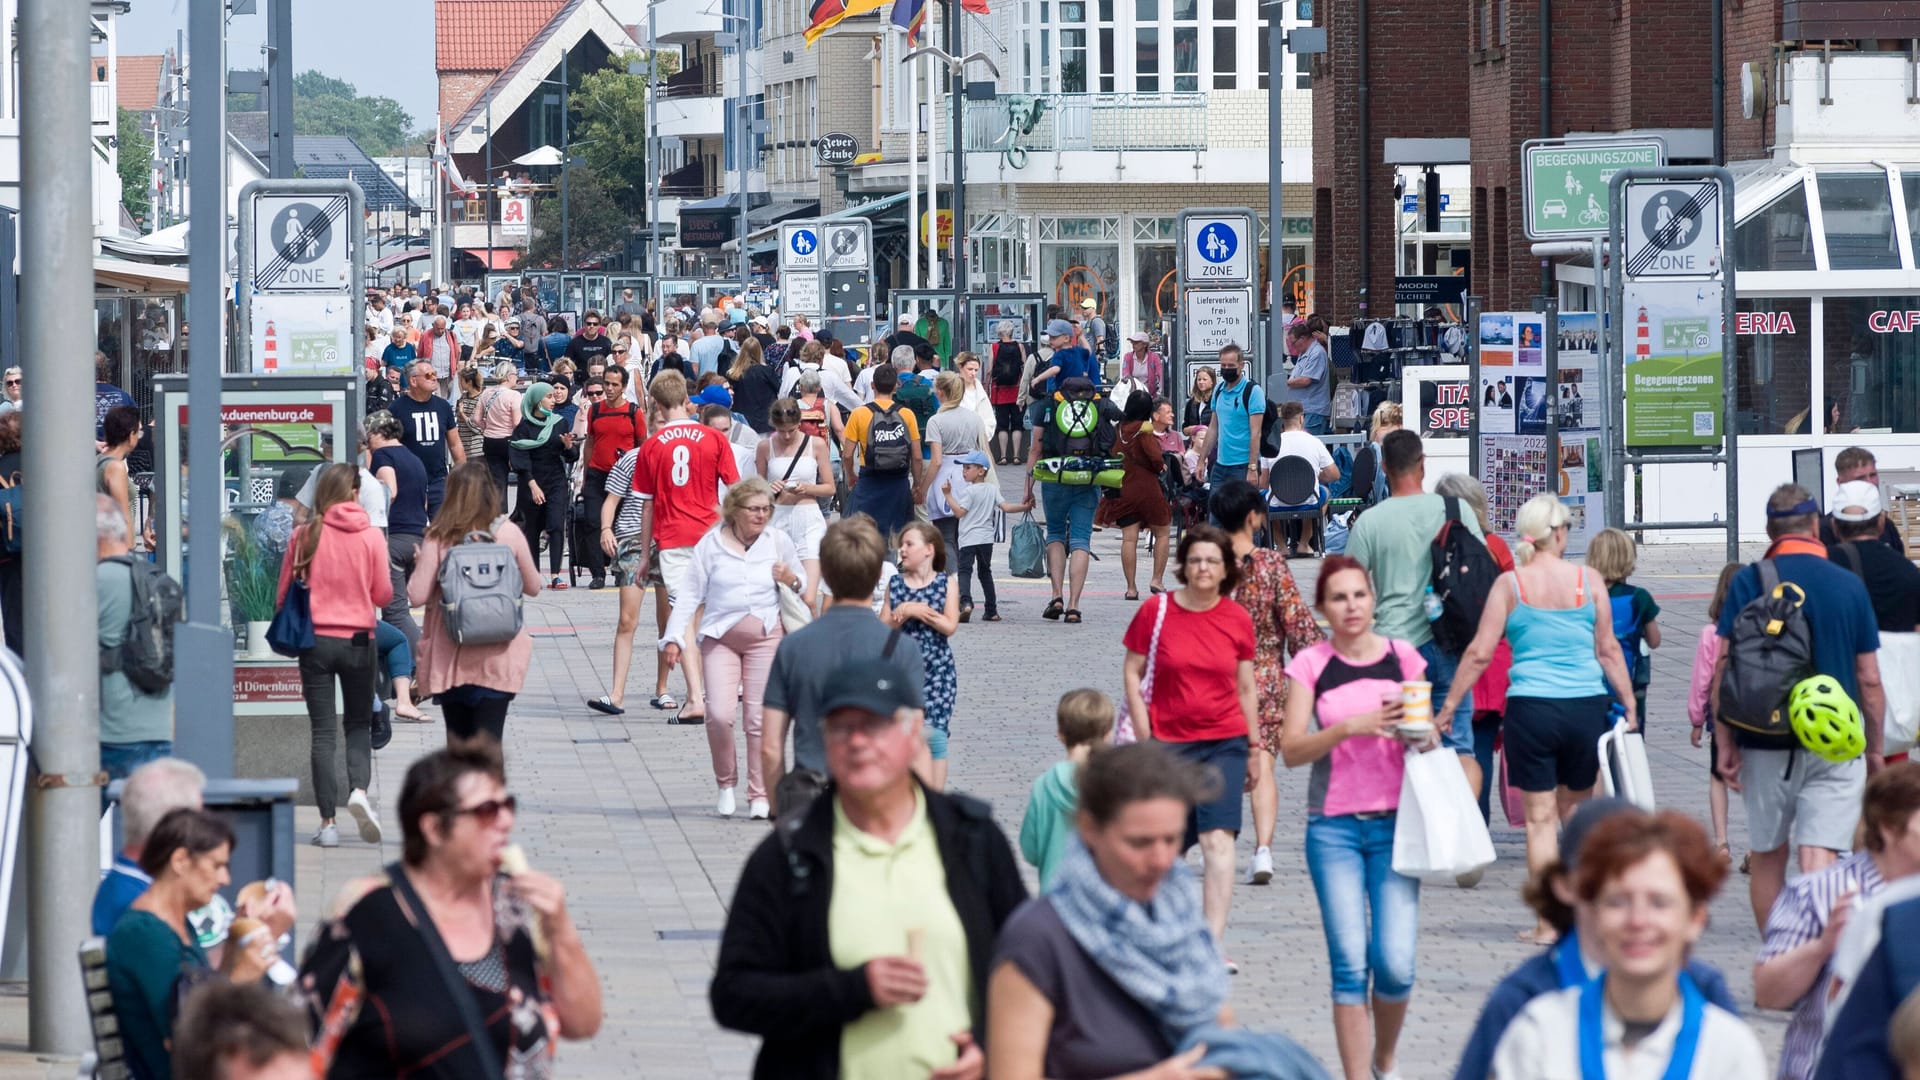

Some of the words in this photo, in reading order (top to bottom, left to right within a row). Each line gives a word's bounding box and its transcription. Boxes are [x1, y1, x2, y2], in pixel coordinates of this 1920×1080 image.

[822, 137, 853, 150] Jever
[822, 149, 853, 159] Stube
[1536, 151, 1653, 167] BEGEGNUNGSZONE
[1650, 255, 1695, 270] ZONE
[279, 268, 325, 283] ZONE
[1202, 266, 1233, 276] ZONE
[1196, 296, 1240, 305] Lieferverkehr
[1216, 317, 1234, 325] 7-10
[1235, 317, 1240, 325] h
[1868, 310, 1920, 333] CAF
[1211, 328, 1227, 336] und
[1698, 336, 1708, 345] 20
[326, 351, 336, 360] 20
[1634, 374, 1714, 386] Begegnungszonen
[1437, 384, 1470, 405] ITA
[1429, 407, 1470, 429] SPE
[411, 411, 440, 442] TH
[657, 427, 705, 445] ROONEY
[1524, 437, 1547, 449] 2022
[671, 444, 690, 487] 8
